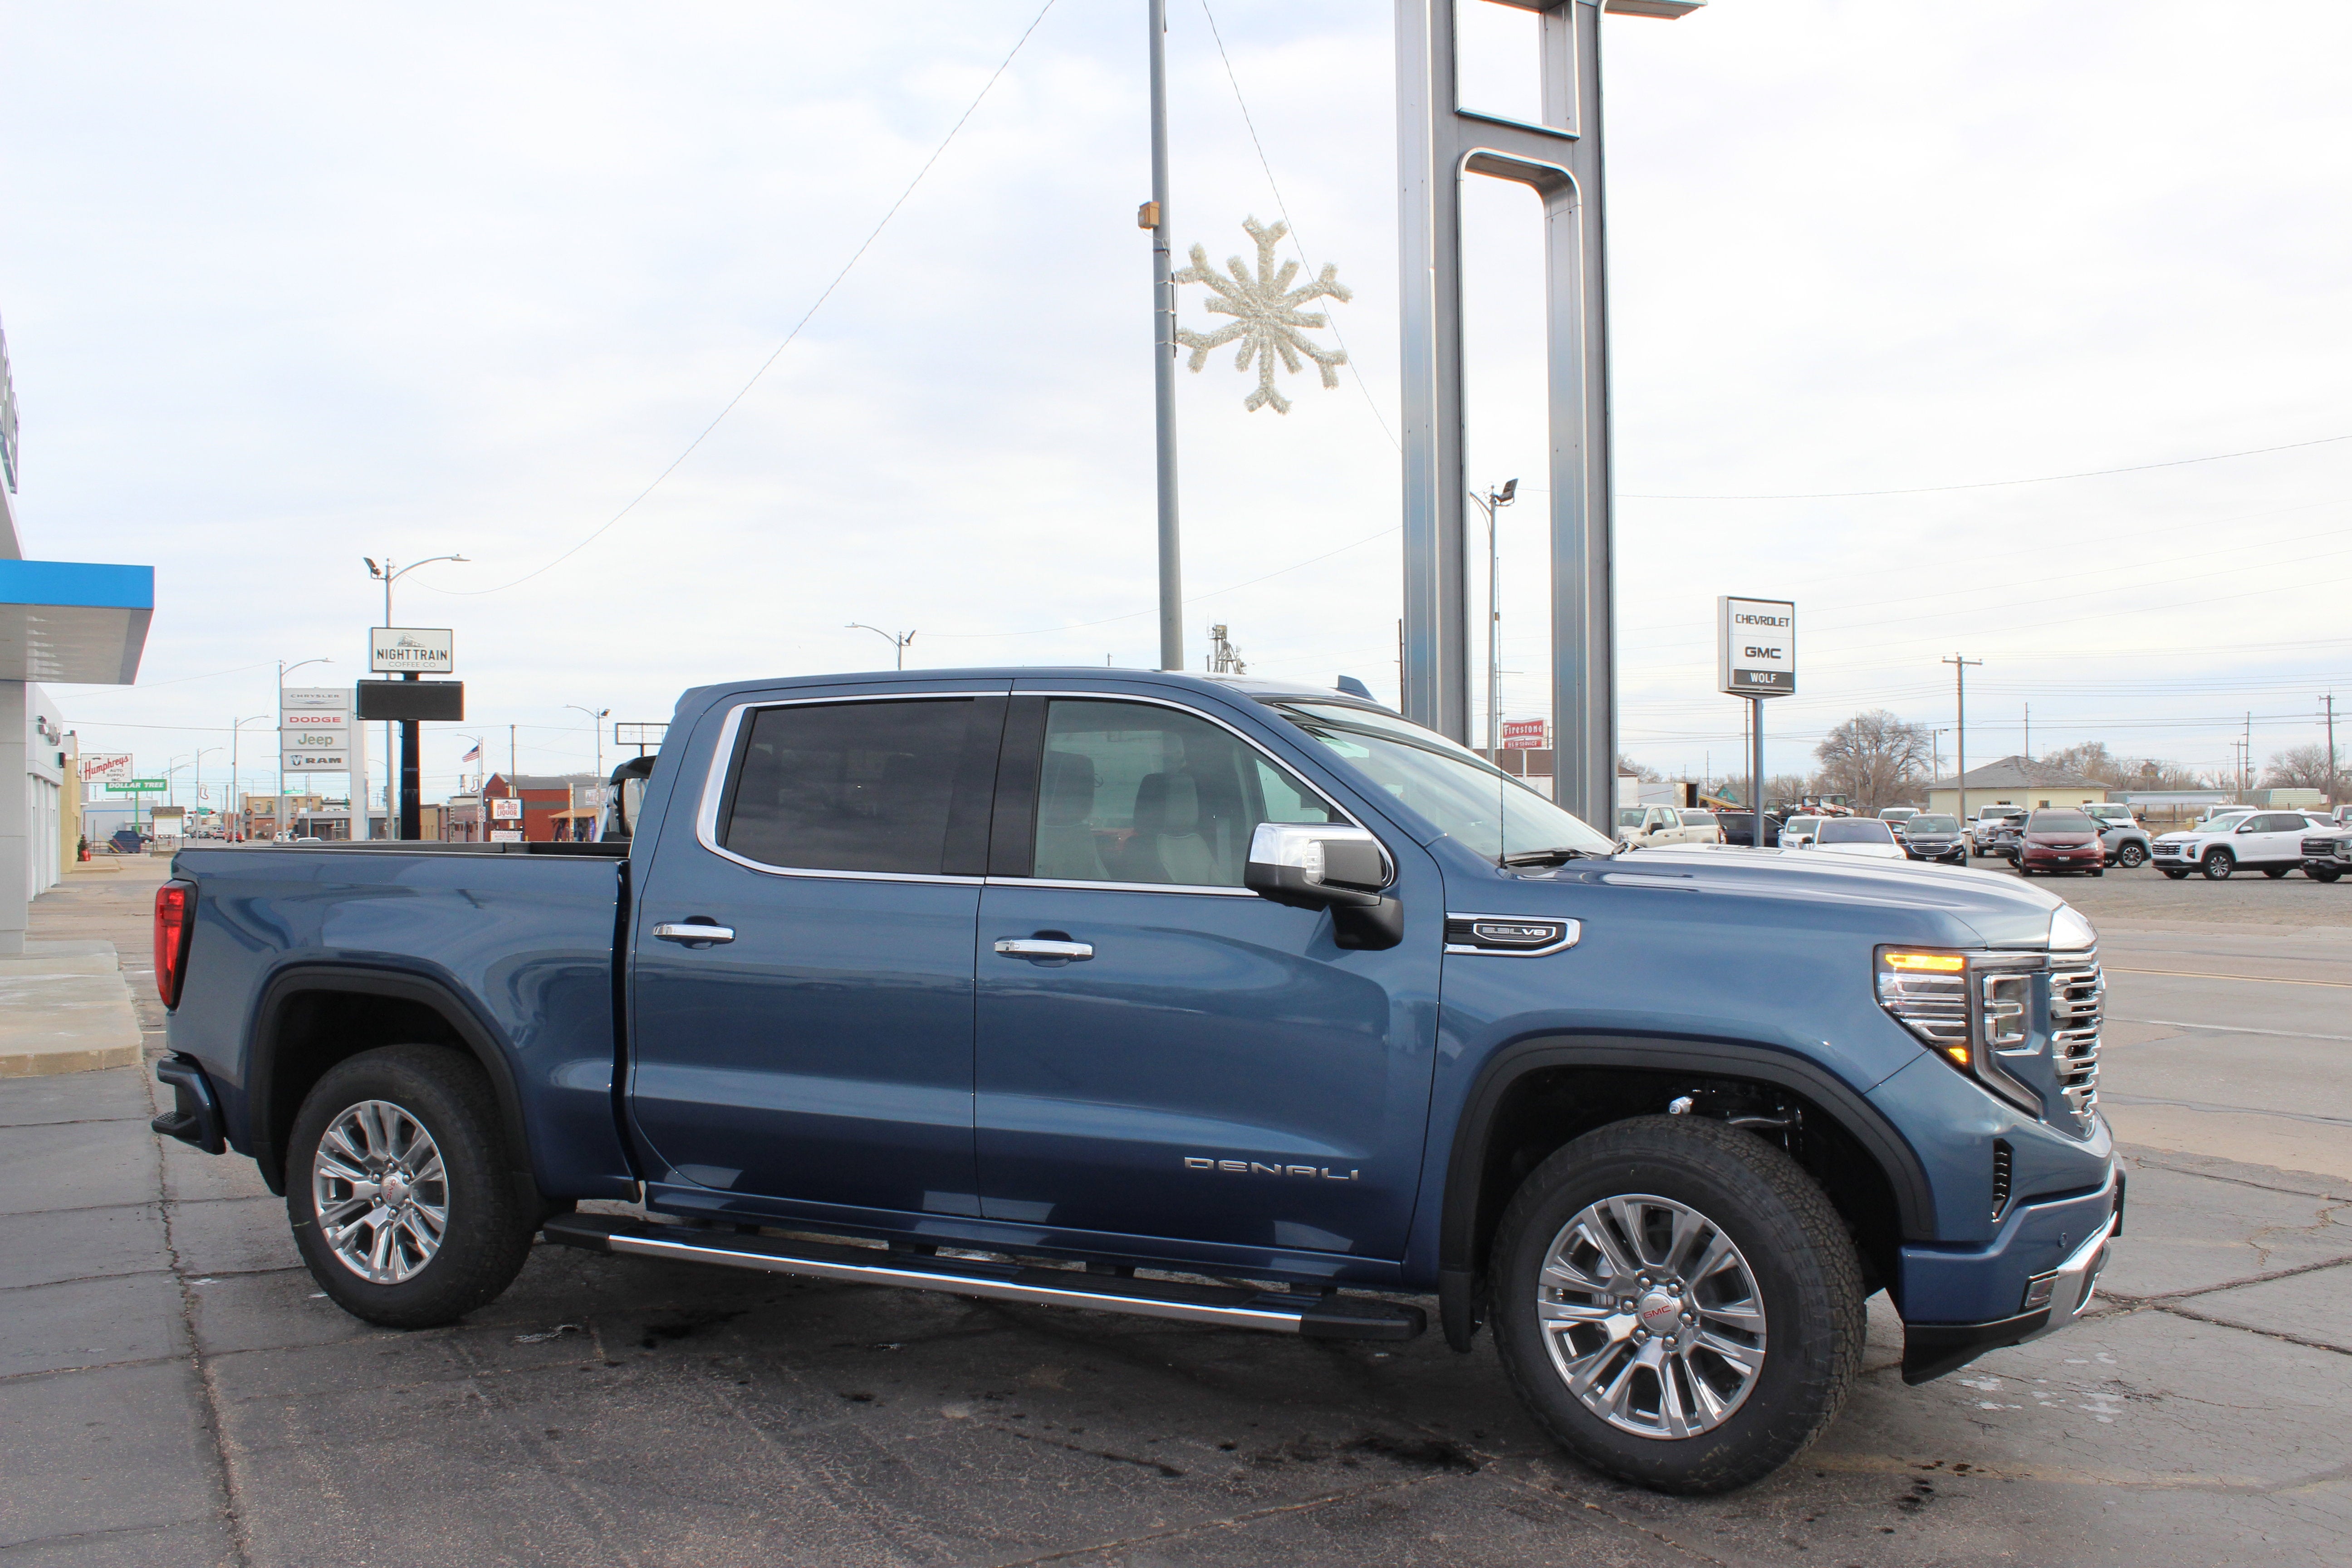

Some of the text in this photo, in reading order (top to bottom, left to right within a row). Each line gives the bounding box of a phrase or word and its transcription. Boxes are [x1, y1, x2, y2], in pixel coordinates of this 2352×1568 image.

[1735, 614, 1790, 627] CHEVROLET
[377, 649, 447, 661] NIGHT TRAIN
[1745, 646, 1781, 659] GMC
[1750, 672, 1776, 683] WOLF
[1504, 725, 1542, 736] Firestone
[298, 733, 333, 747] Jeep
[84, 755, 129, 781] Humphreys
[1184, 1157, 1358, 1180] DENALI
[387, 1179, 396, 1200] GMC
[1643, 1305, 1671, 1318] GMC
